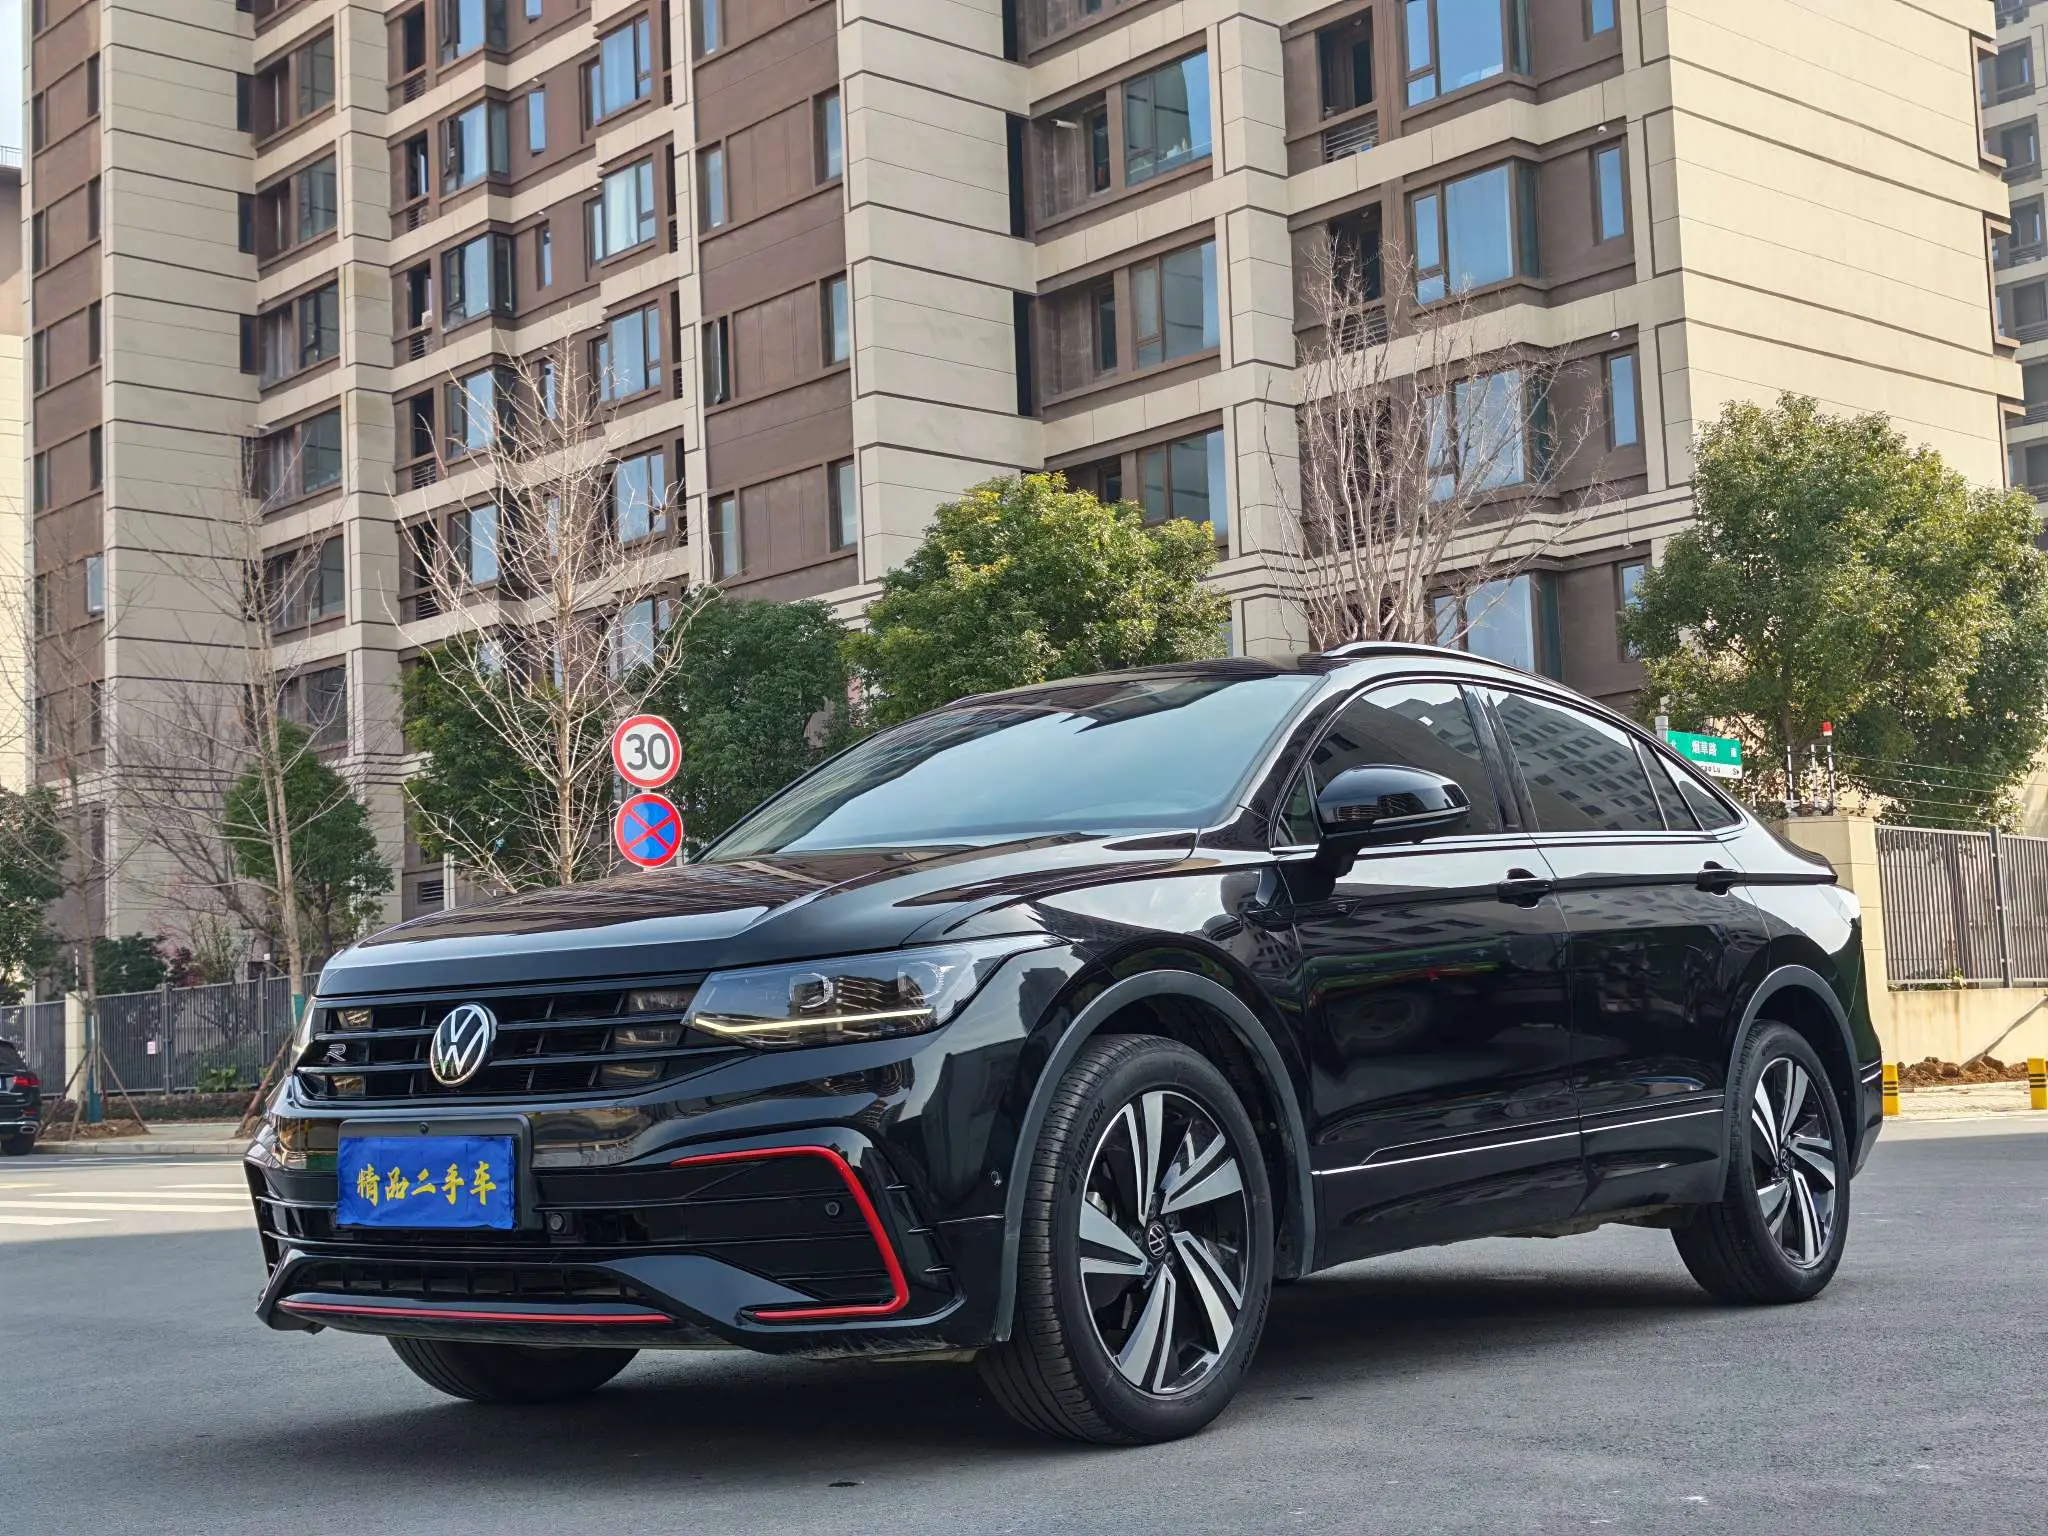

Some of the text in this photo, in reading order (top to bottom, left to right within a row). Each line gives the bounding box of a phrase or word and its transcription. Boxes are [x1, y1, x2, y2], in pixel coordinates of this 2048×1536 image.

[625, 733, 671, 771] 30
[326, 1043, 347, 1062] R
[356, 1160, 498, 1207] 精品二手车
